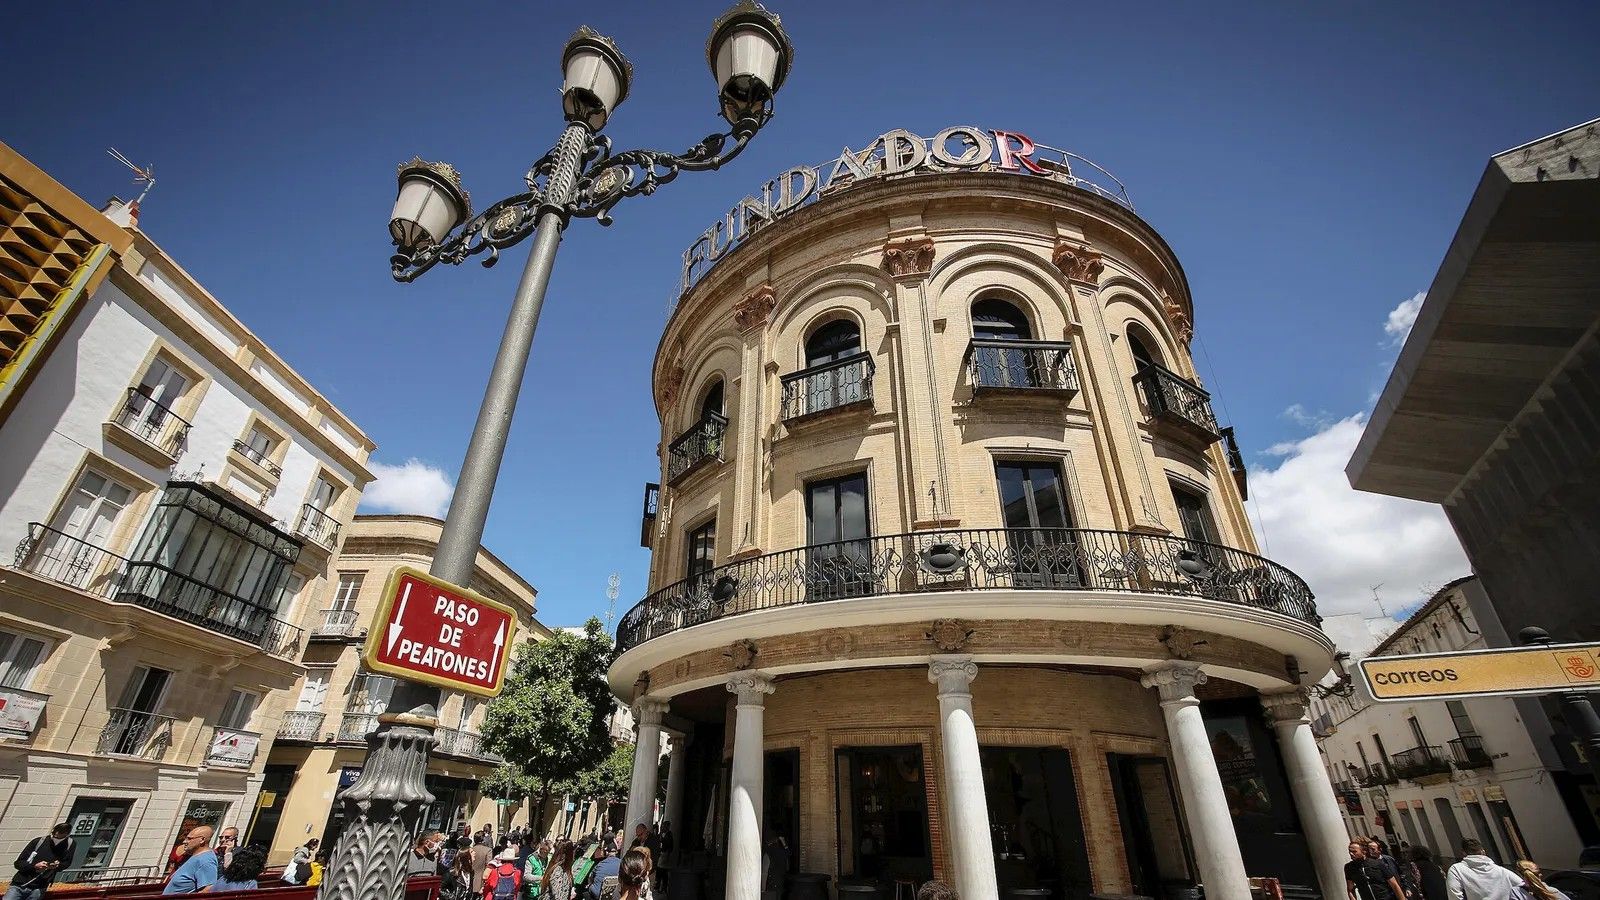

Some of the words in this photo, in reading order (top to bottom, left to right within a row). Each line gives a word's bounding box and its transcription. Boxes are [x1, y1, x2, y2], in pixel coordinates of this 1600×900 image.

[681, 125, 1055, 294] FUNDADOR
[433, 595, 479, 627] PASO
[438, 623, 464, 648] DE
[397, 638, 488, 681] PEATONES
[1374, 668, 1458, 685] correos
